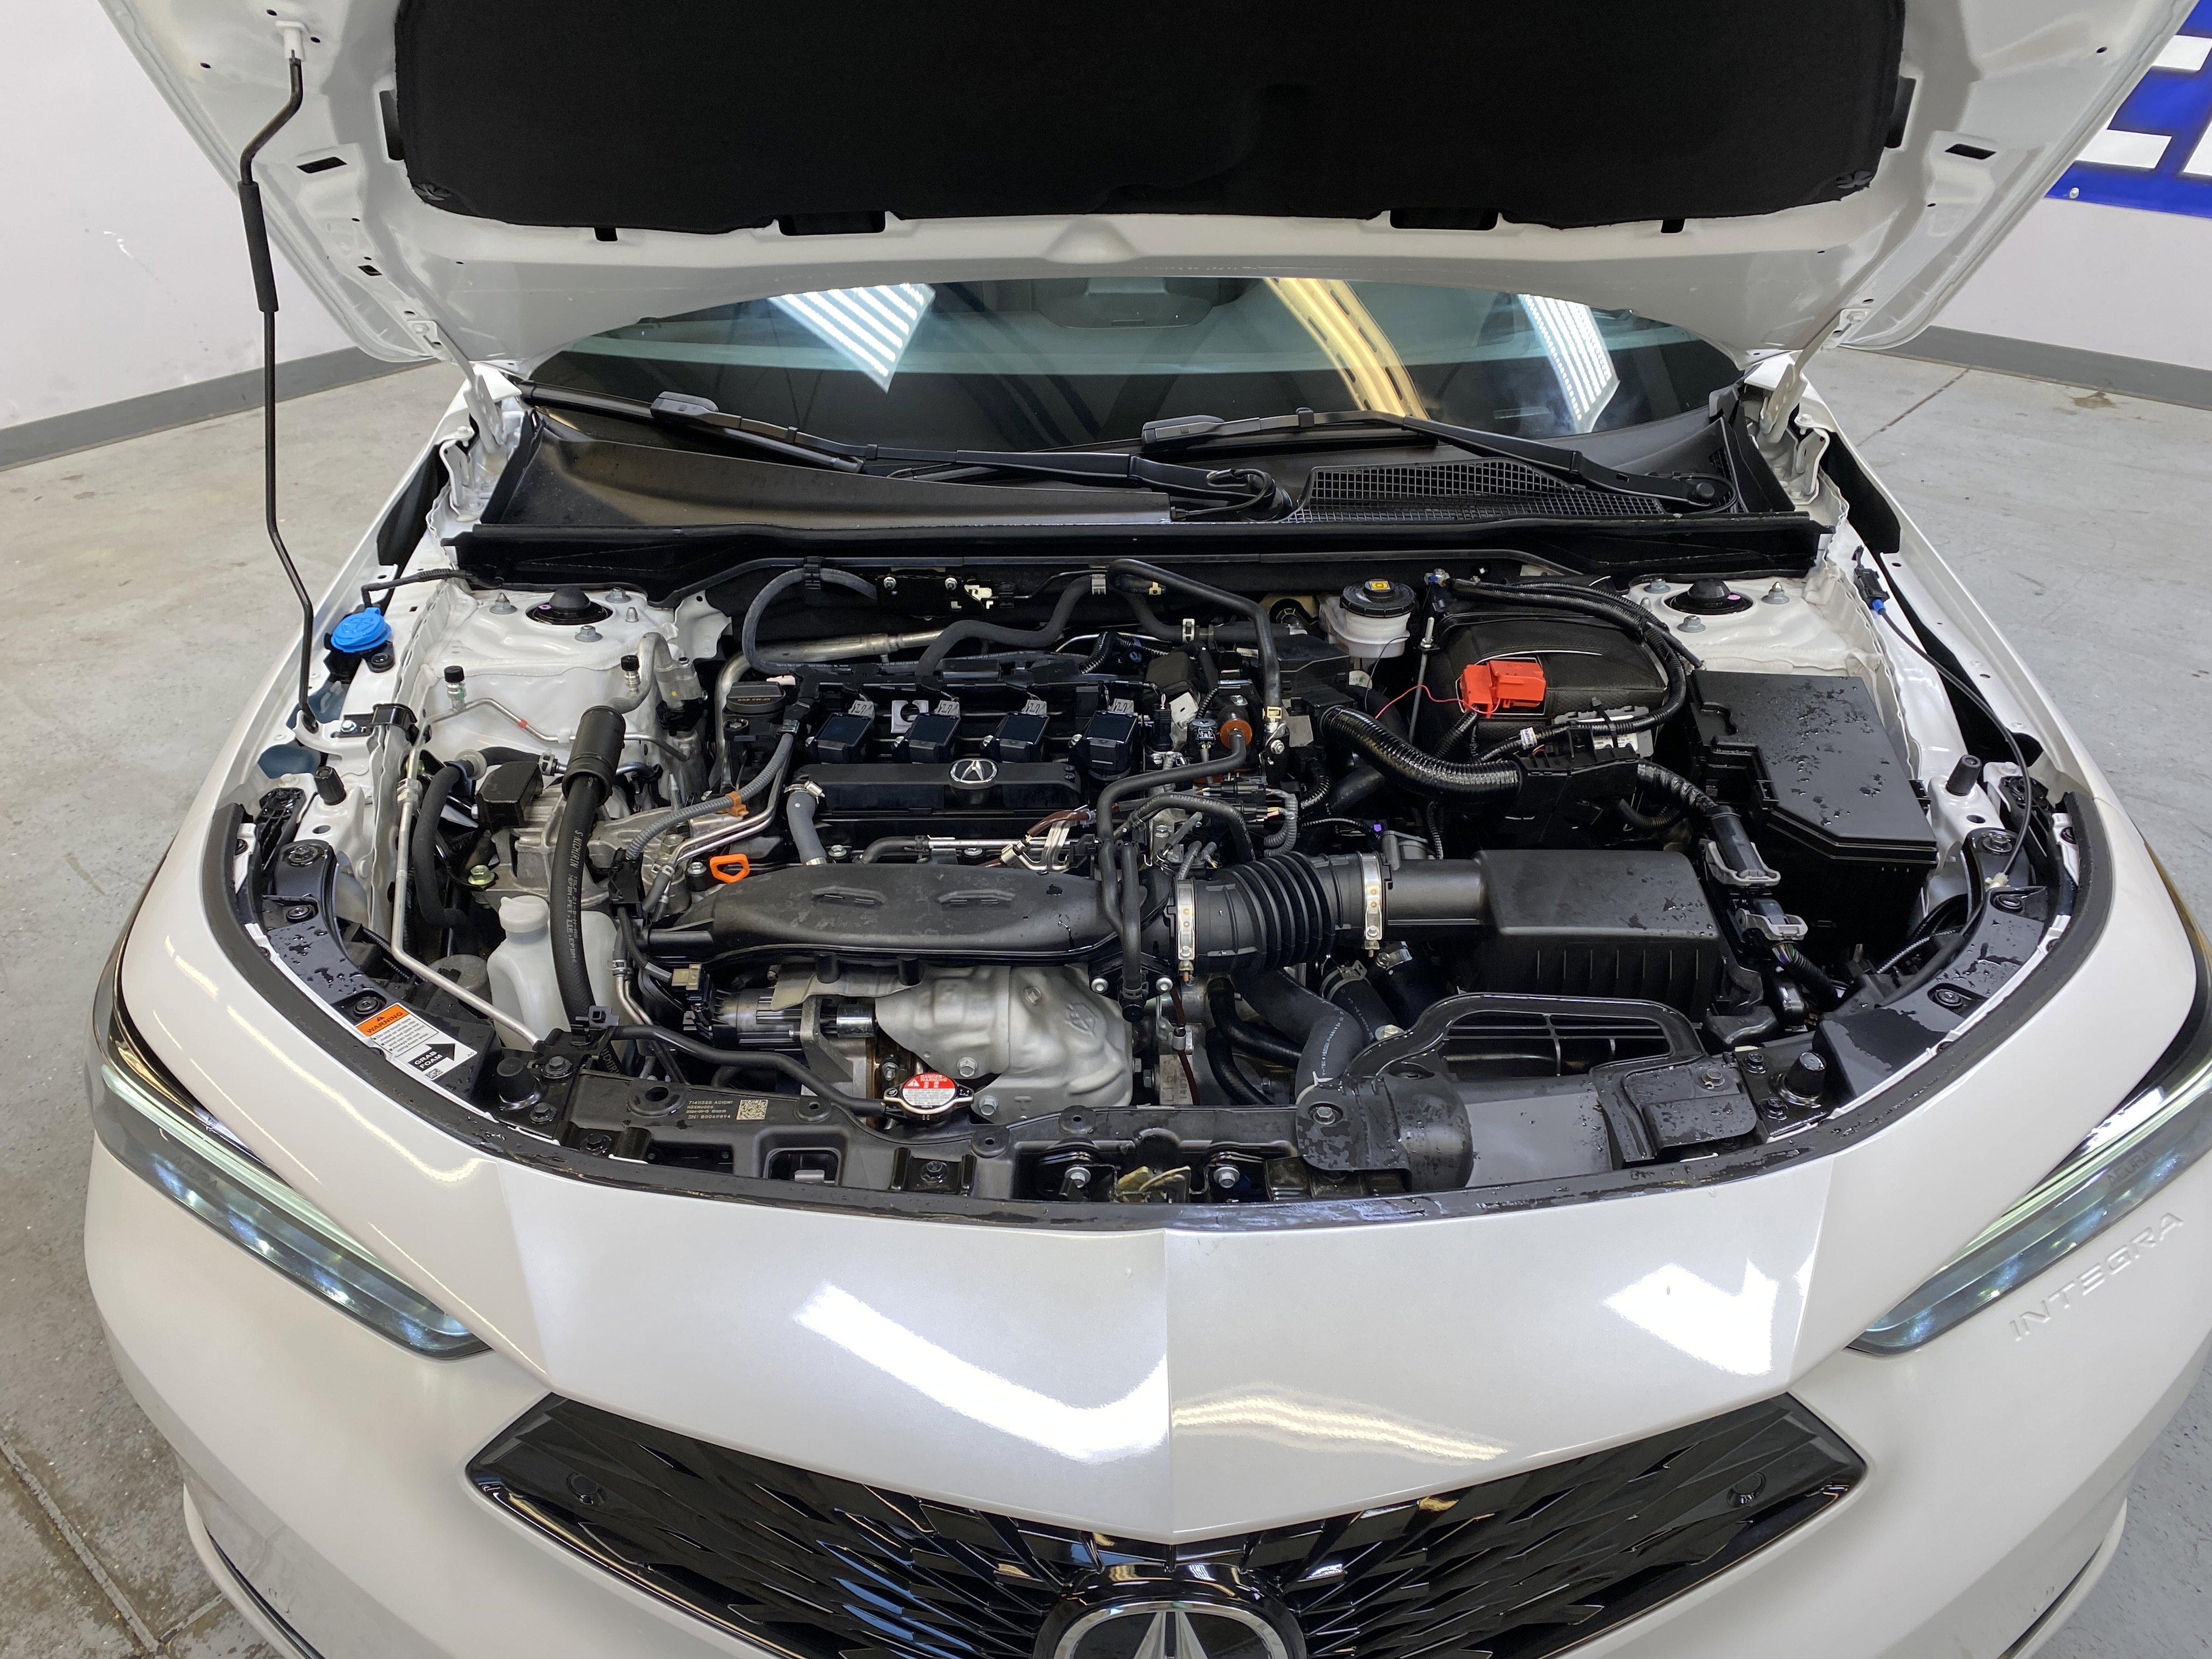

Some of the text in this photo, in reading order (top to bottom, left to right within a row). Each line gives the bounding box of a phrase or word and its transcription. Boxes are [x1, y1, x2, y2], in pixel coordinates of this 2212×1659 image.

[365, 1011, 404, 1034] WARNING
[414, 1051, 437, 1065] GRAB
[419, 1054, 443, 1069] FOAM
[601, 1048, 619, 1074] ICHIR
[2107, 1148, 2155, 1186] ACURA
[2009, 1212, 2185, 1342] INTEGRA
